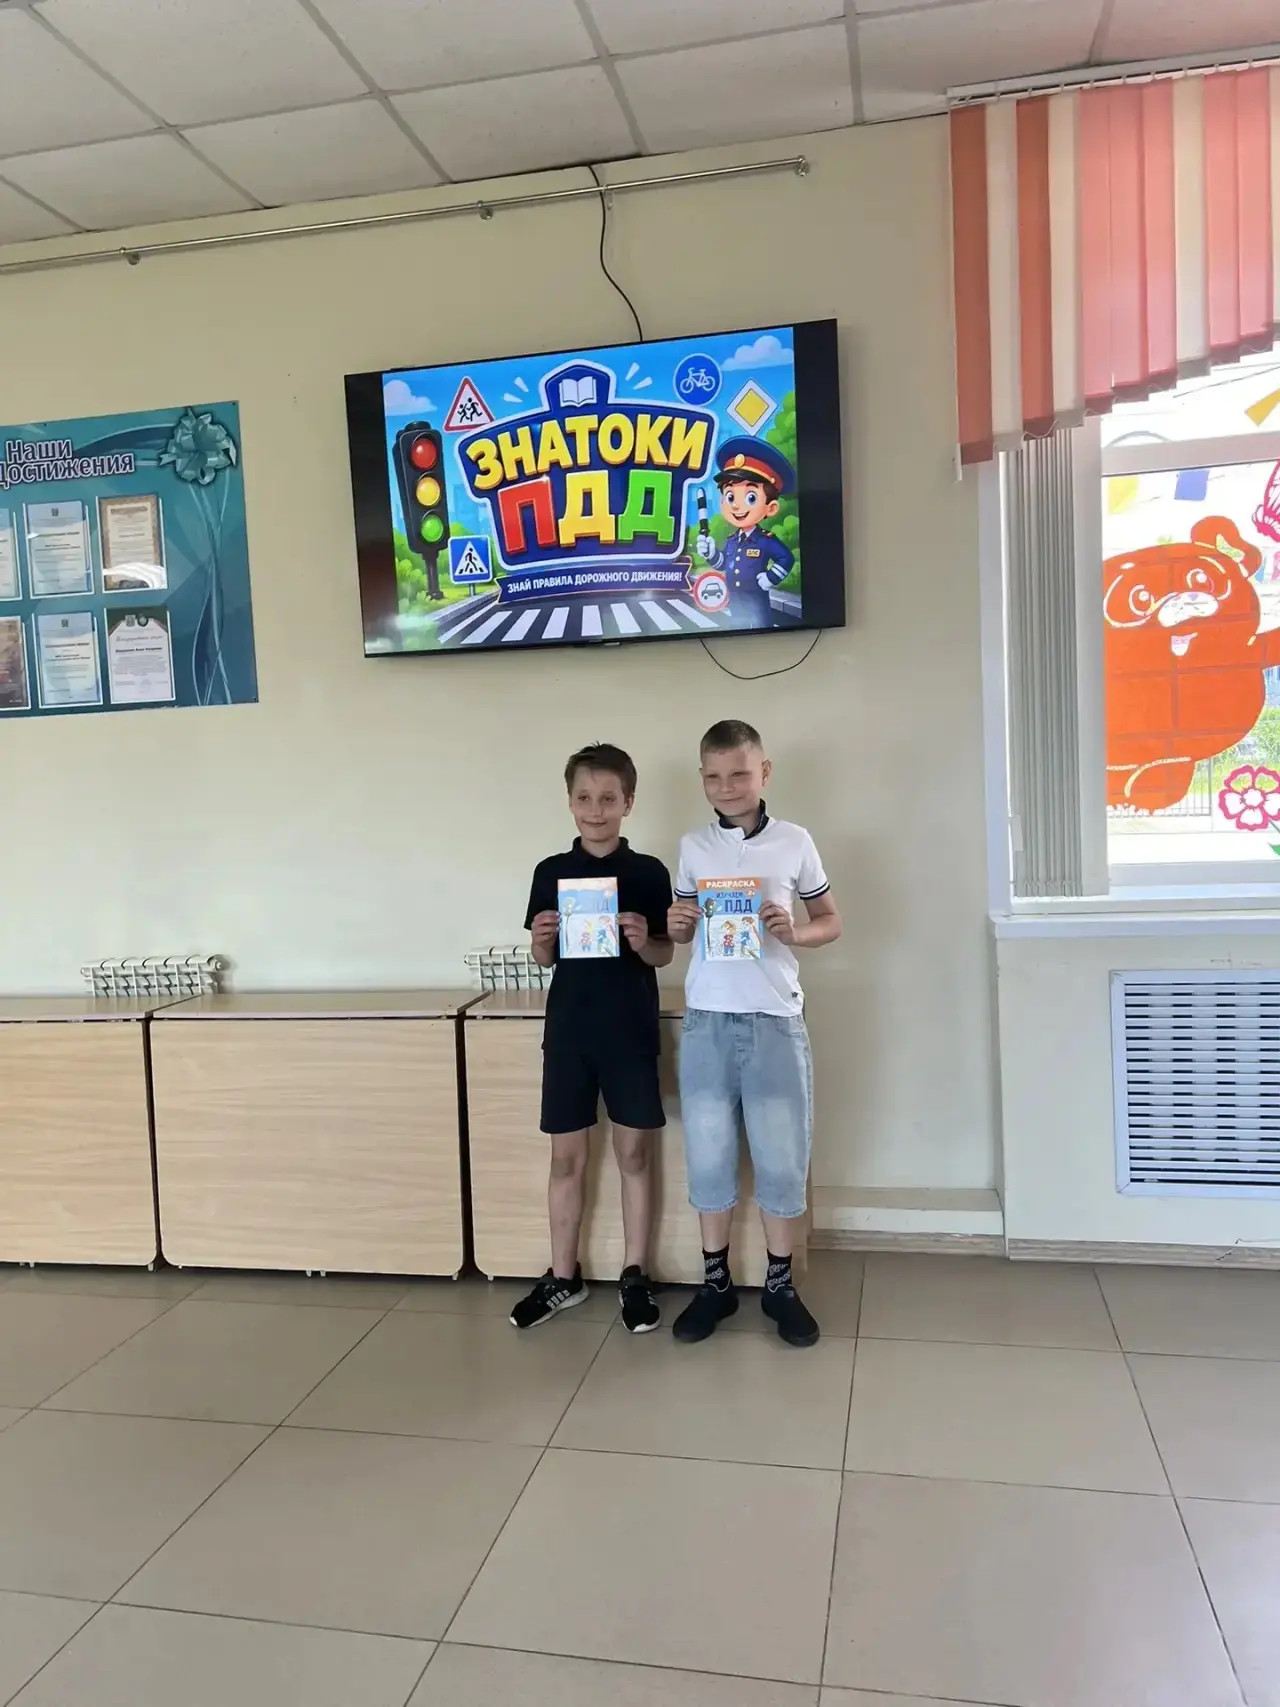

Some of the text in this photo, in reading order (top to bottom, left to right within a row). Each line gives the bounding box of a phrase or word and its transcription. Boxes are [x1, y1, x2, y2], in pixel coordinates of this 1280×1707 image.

[6, 439, 73, 464] Наши
[466, 413, 708, 490] ЗНАТОКИ
[498, 469, 675, 554] ПДД
[507, 571, 683, 594] ЗНАЙ ПРАВИЛА ДОРОЖНОГО ДВИЖЕНИЯ!
[705, 879, 756, 889] РАСКРАСКА
[724, 899, 753, 914] ПДД
